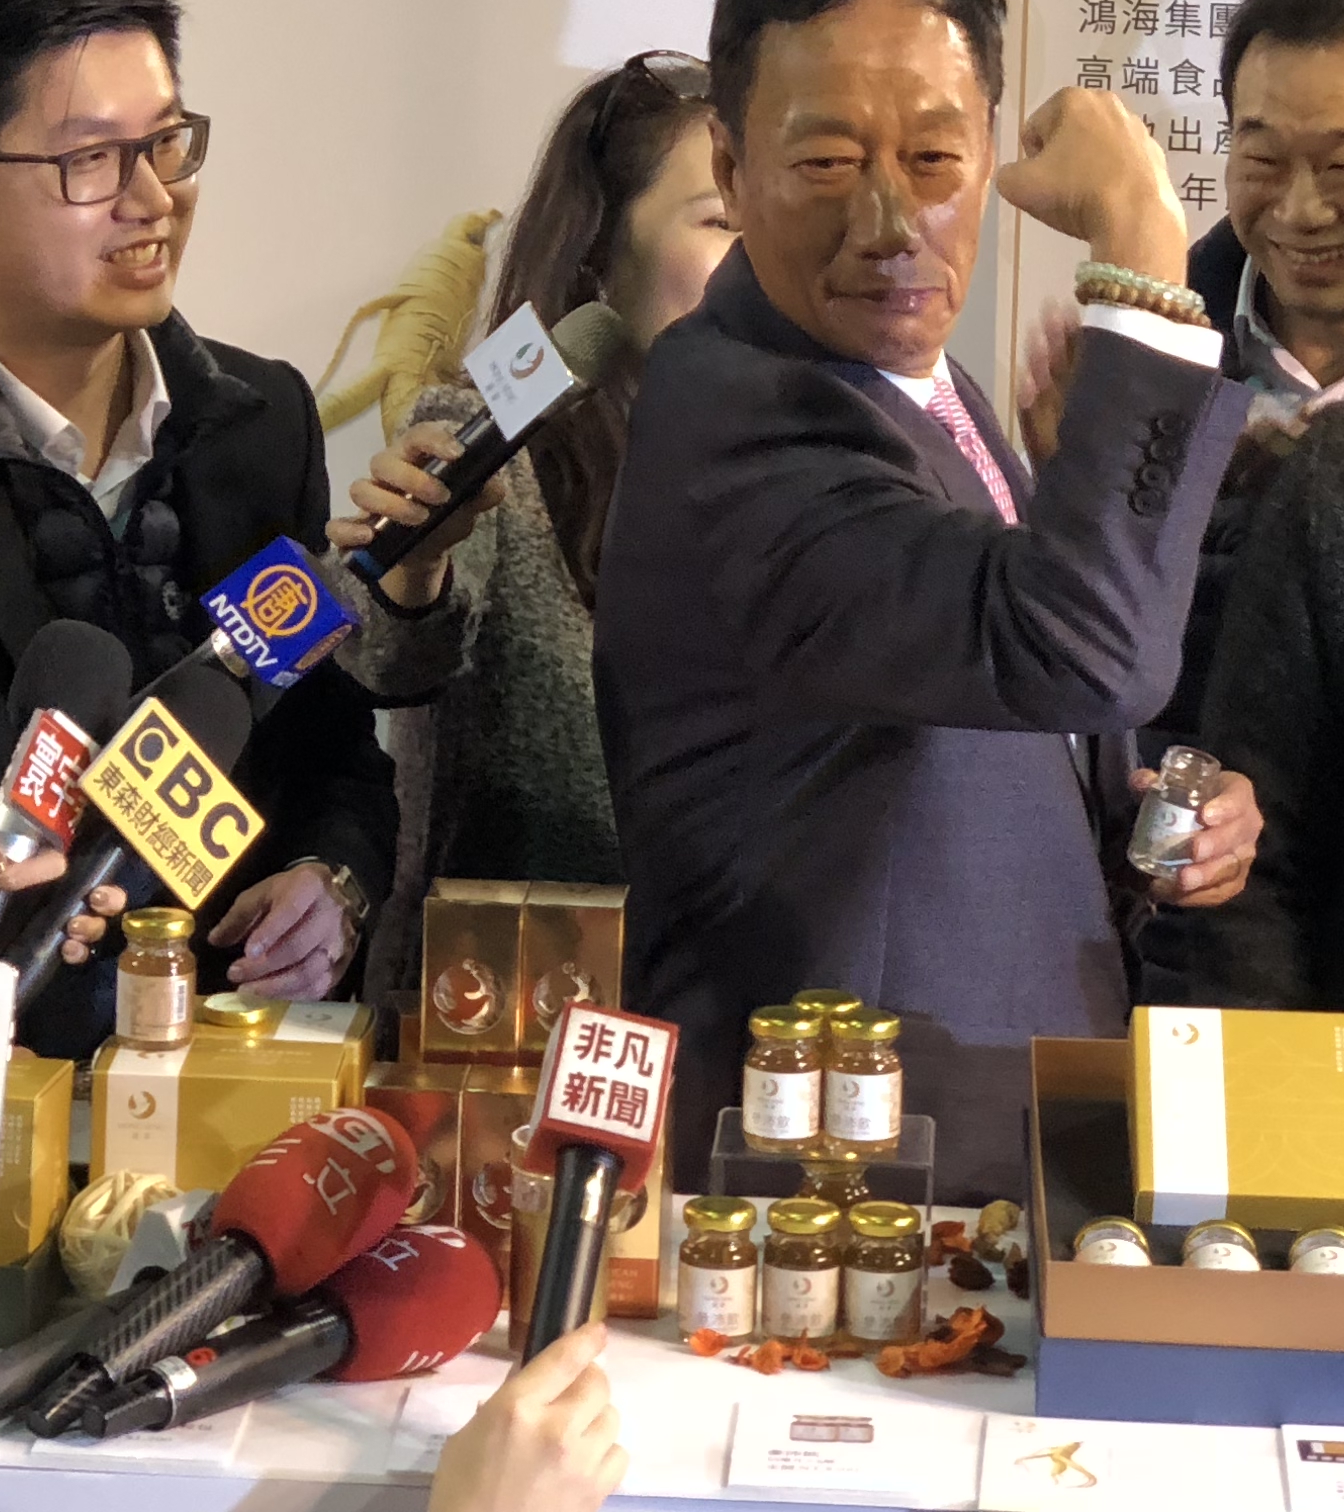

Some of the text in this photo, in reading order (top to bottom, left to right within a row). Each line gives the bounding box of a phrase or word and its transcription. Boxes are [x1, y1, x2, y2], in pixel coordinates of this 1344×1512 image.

[208, 592, 279, 668] NTDTV
[93, 760, 214, 898] 東森財經新聞
[573, 1021, 654, 1078] 非凡
[560, 1071, 649, 1129] 新聞
